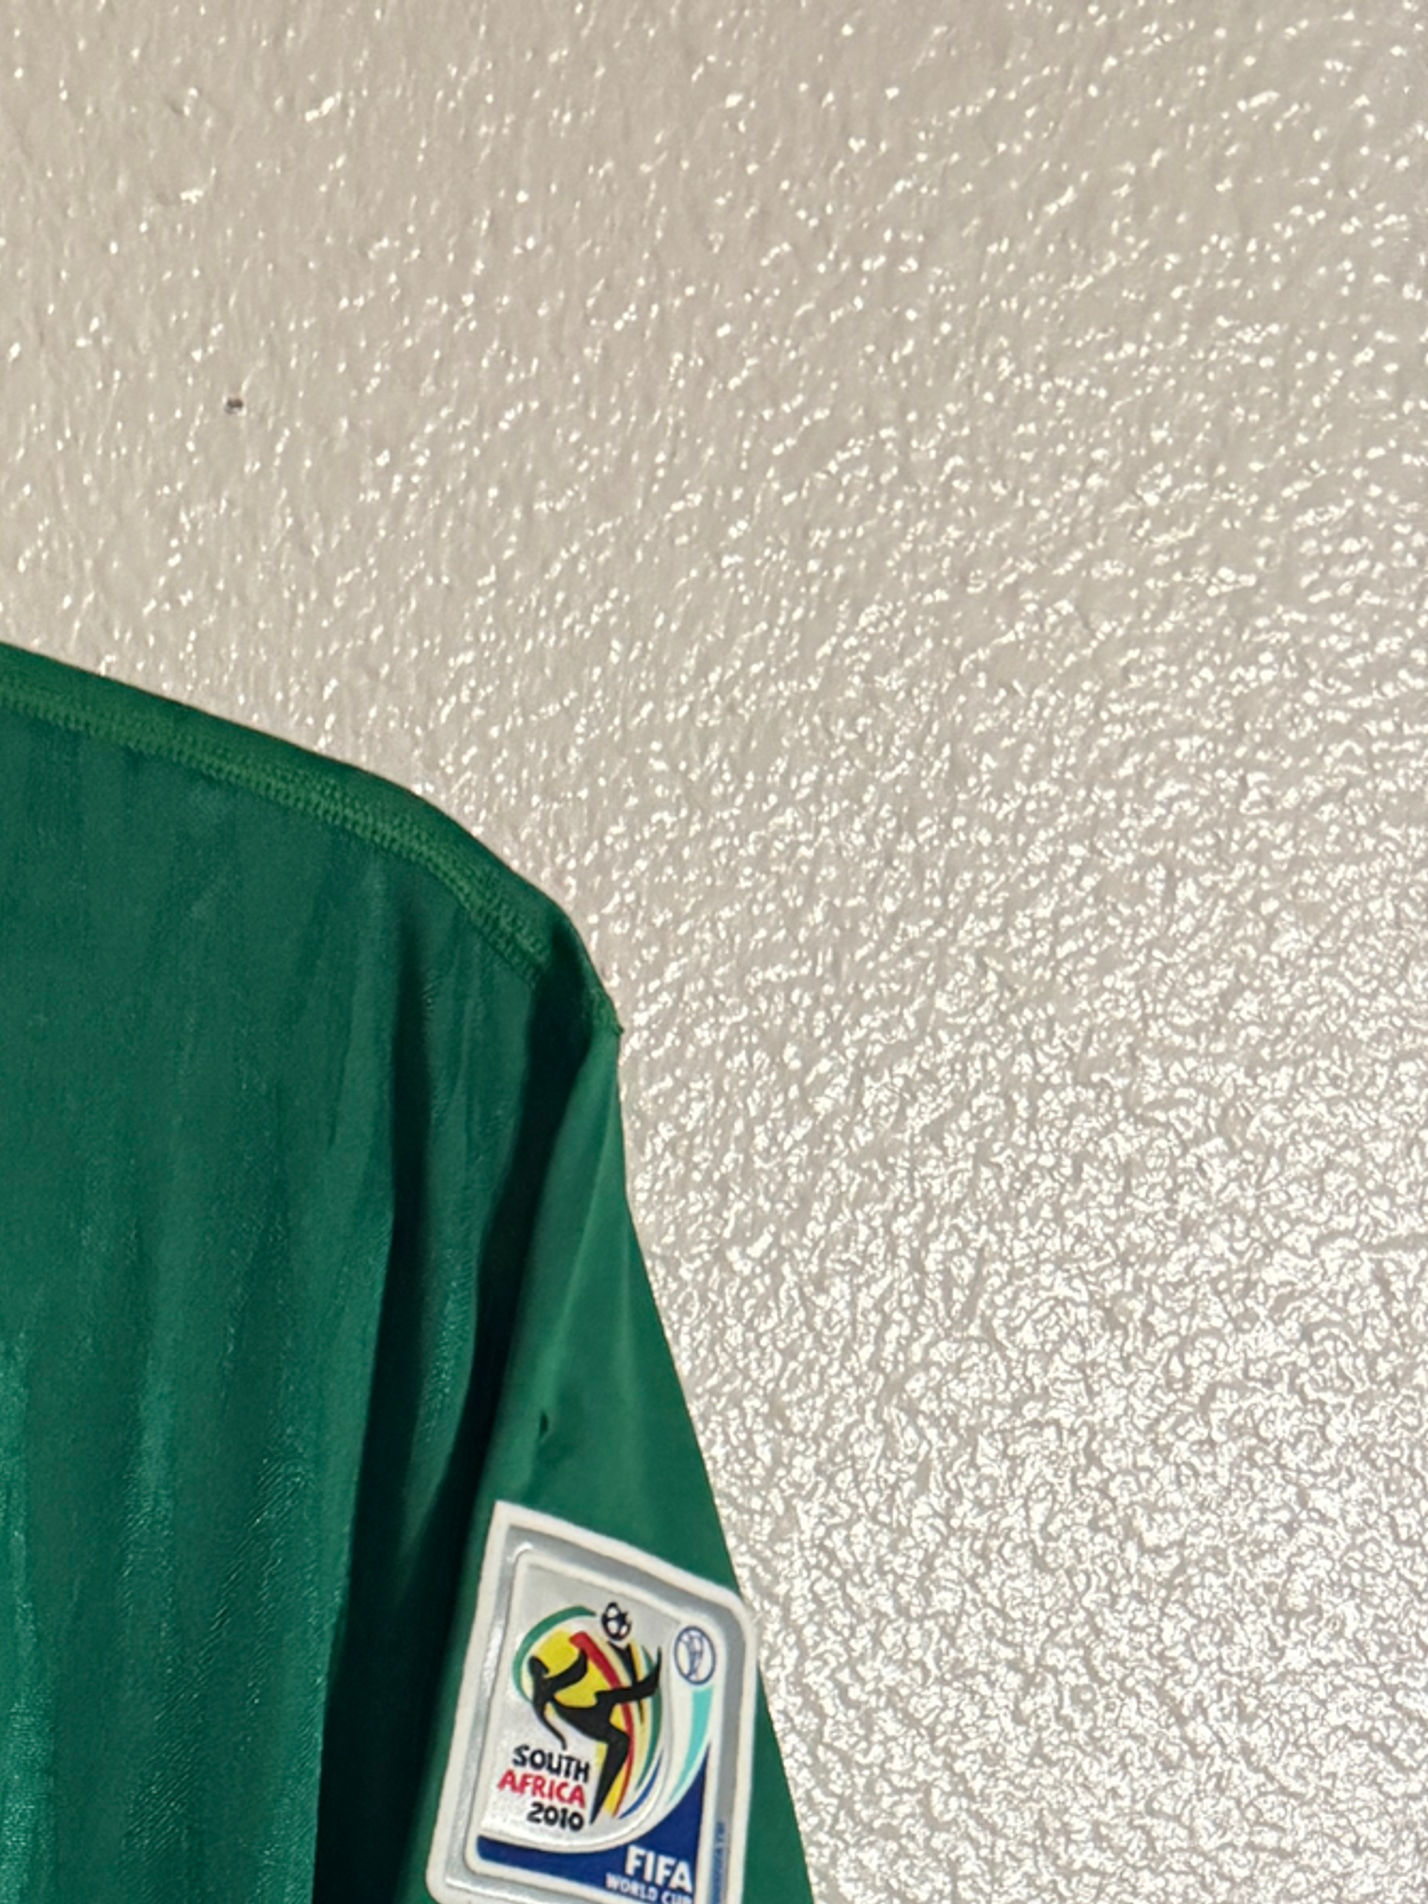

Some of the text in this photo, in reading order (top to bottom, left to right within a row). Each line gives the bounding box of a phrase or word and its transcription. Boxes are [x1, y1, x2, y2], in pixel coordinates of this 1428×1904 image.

[512, 1744, 590, 1784] SOUTH
[497, 1769, 586, 1809] AFRICA
[526, 1801, 585, 1833] 2010
[605, 1872, 658, 1902] WORLD
[624, 1844, 693, 1893] FIFA
